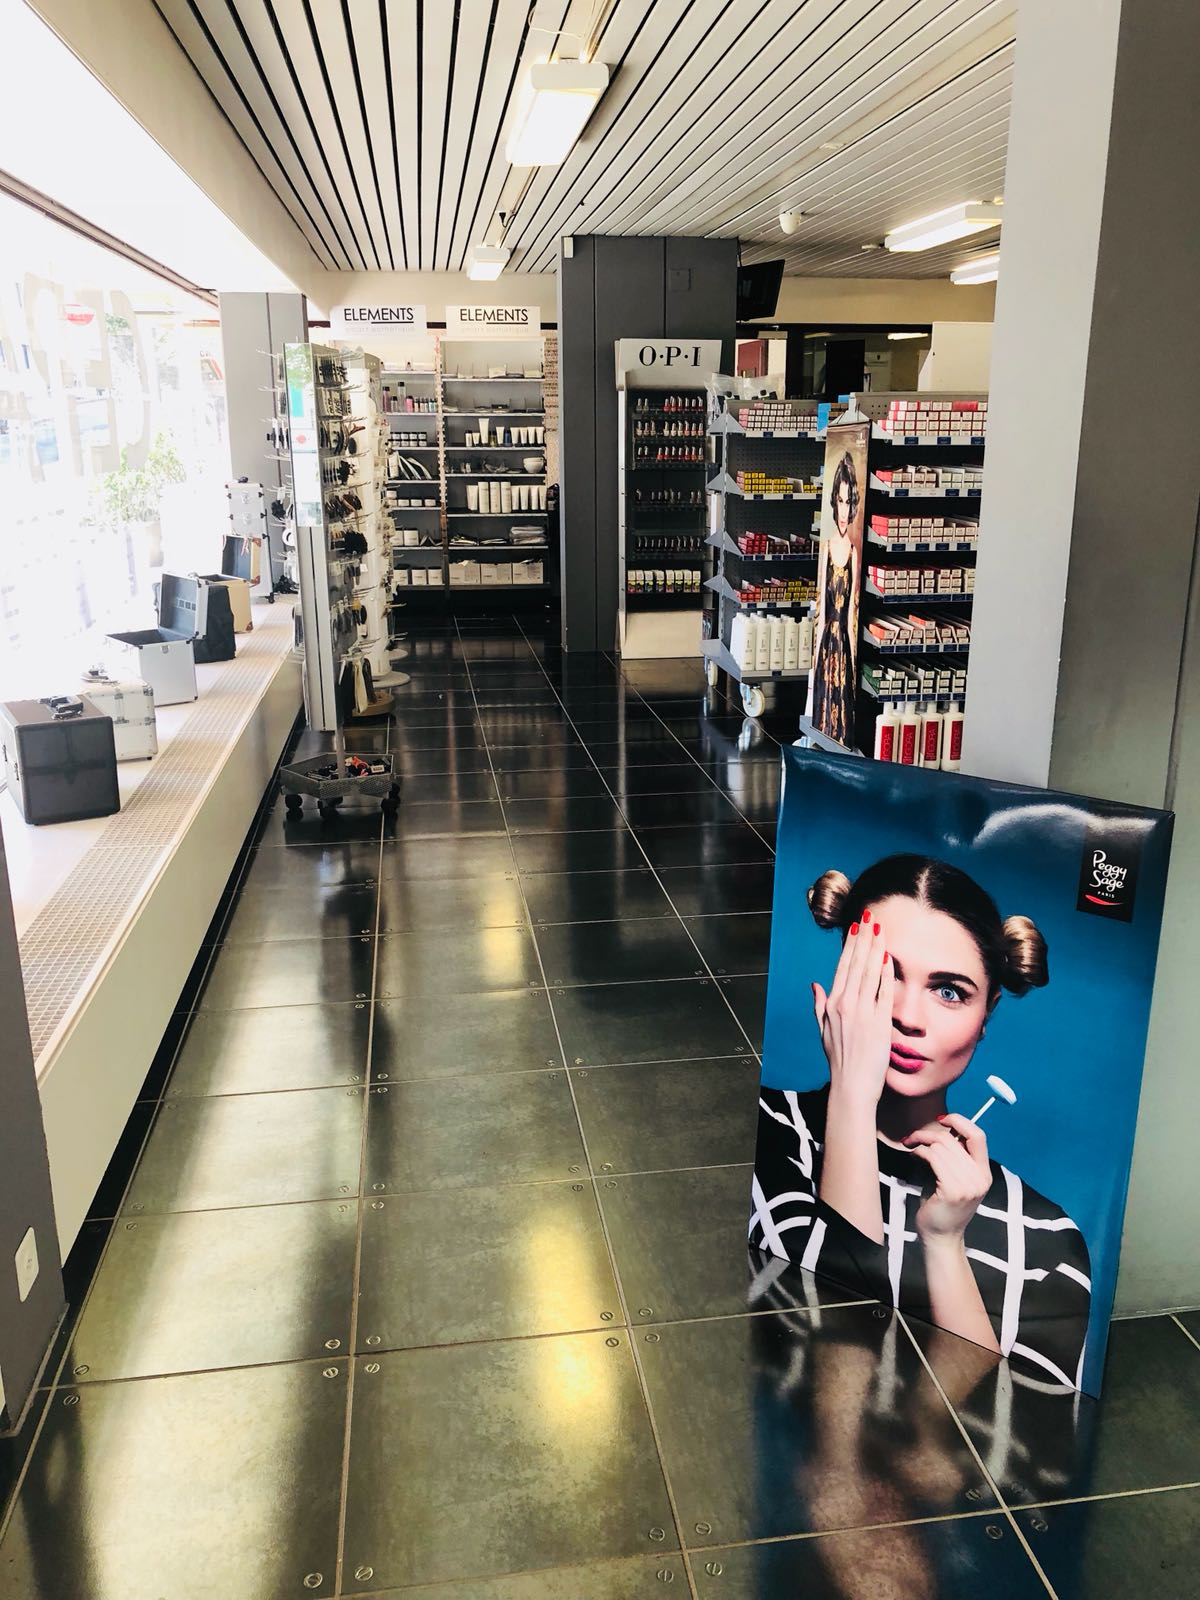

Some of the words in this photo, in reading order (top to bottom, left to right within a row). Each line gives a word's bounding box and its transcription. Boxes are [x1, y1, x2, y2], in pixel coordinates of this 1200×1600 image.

[343, 307, 415, 322] ELEMENTS
[459, 308, 529, 322] ELEMENTS
[1093, 849, 1127, 880] Peggy
[1089, 870, 1124, 892] Sage
